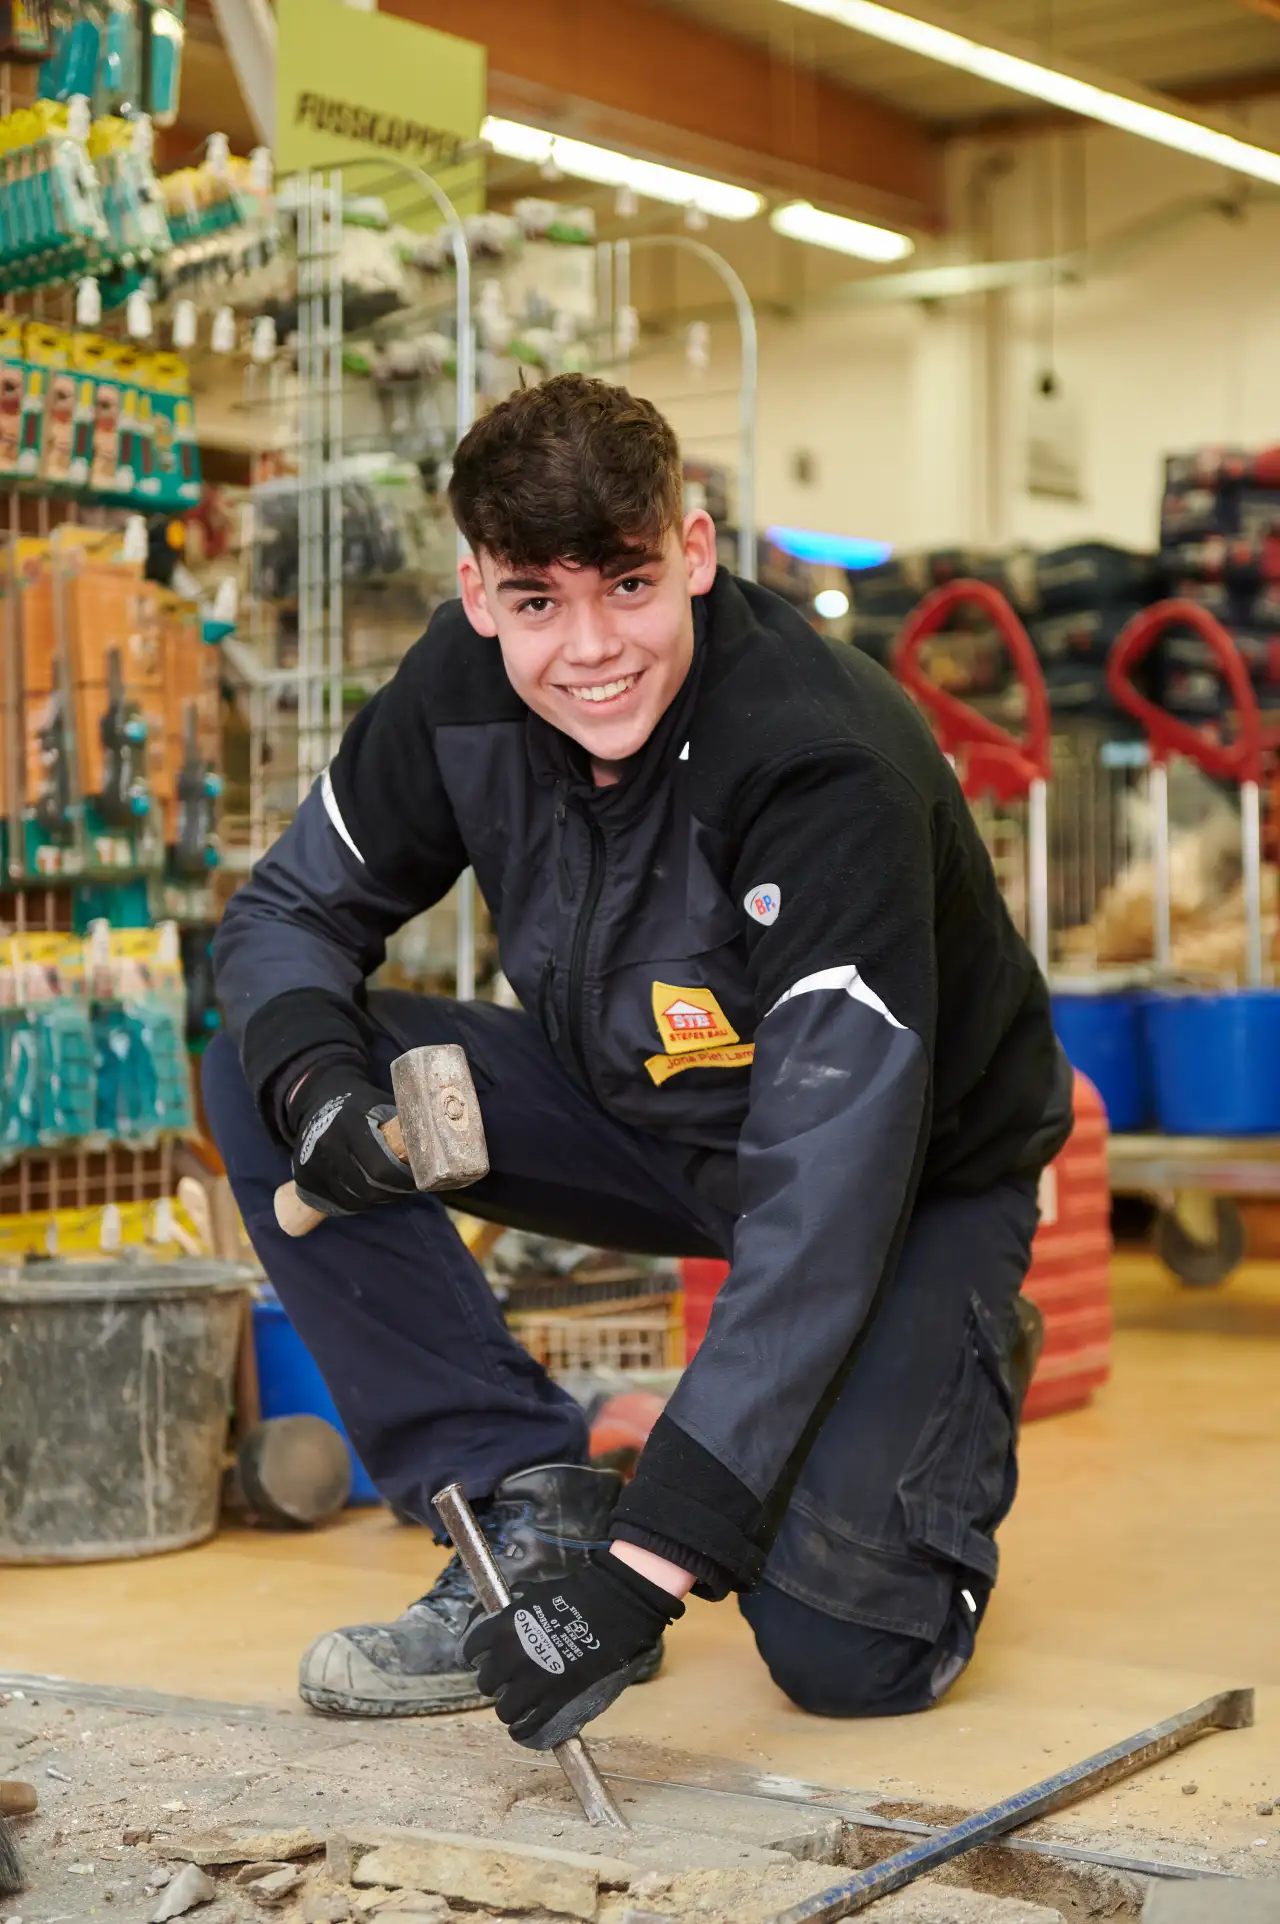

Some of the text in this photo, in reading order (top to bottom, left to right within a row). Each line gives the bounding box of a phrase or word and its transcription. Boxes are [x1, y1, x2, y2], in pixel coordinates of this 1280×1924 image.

[673, 1014, 711, 1029] STB
[698, 1051, 724, 1061] Piet
[516, 1611, 561, 1672] STRONG
[550, 1618, 584, 1657] GROESSE 10
